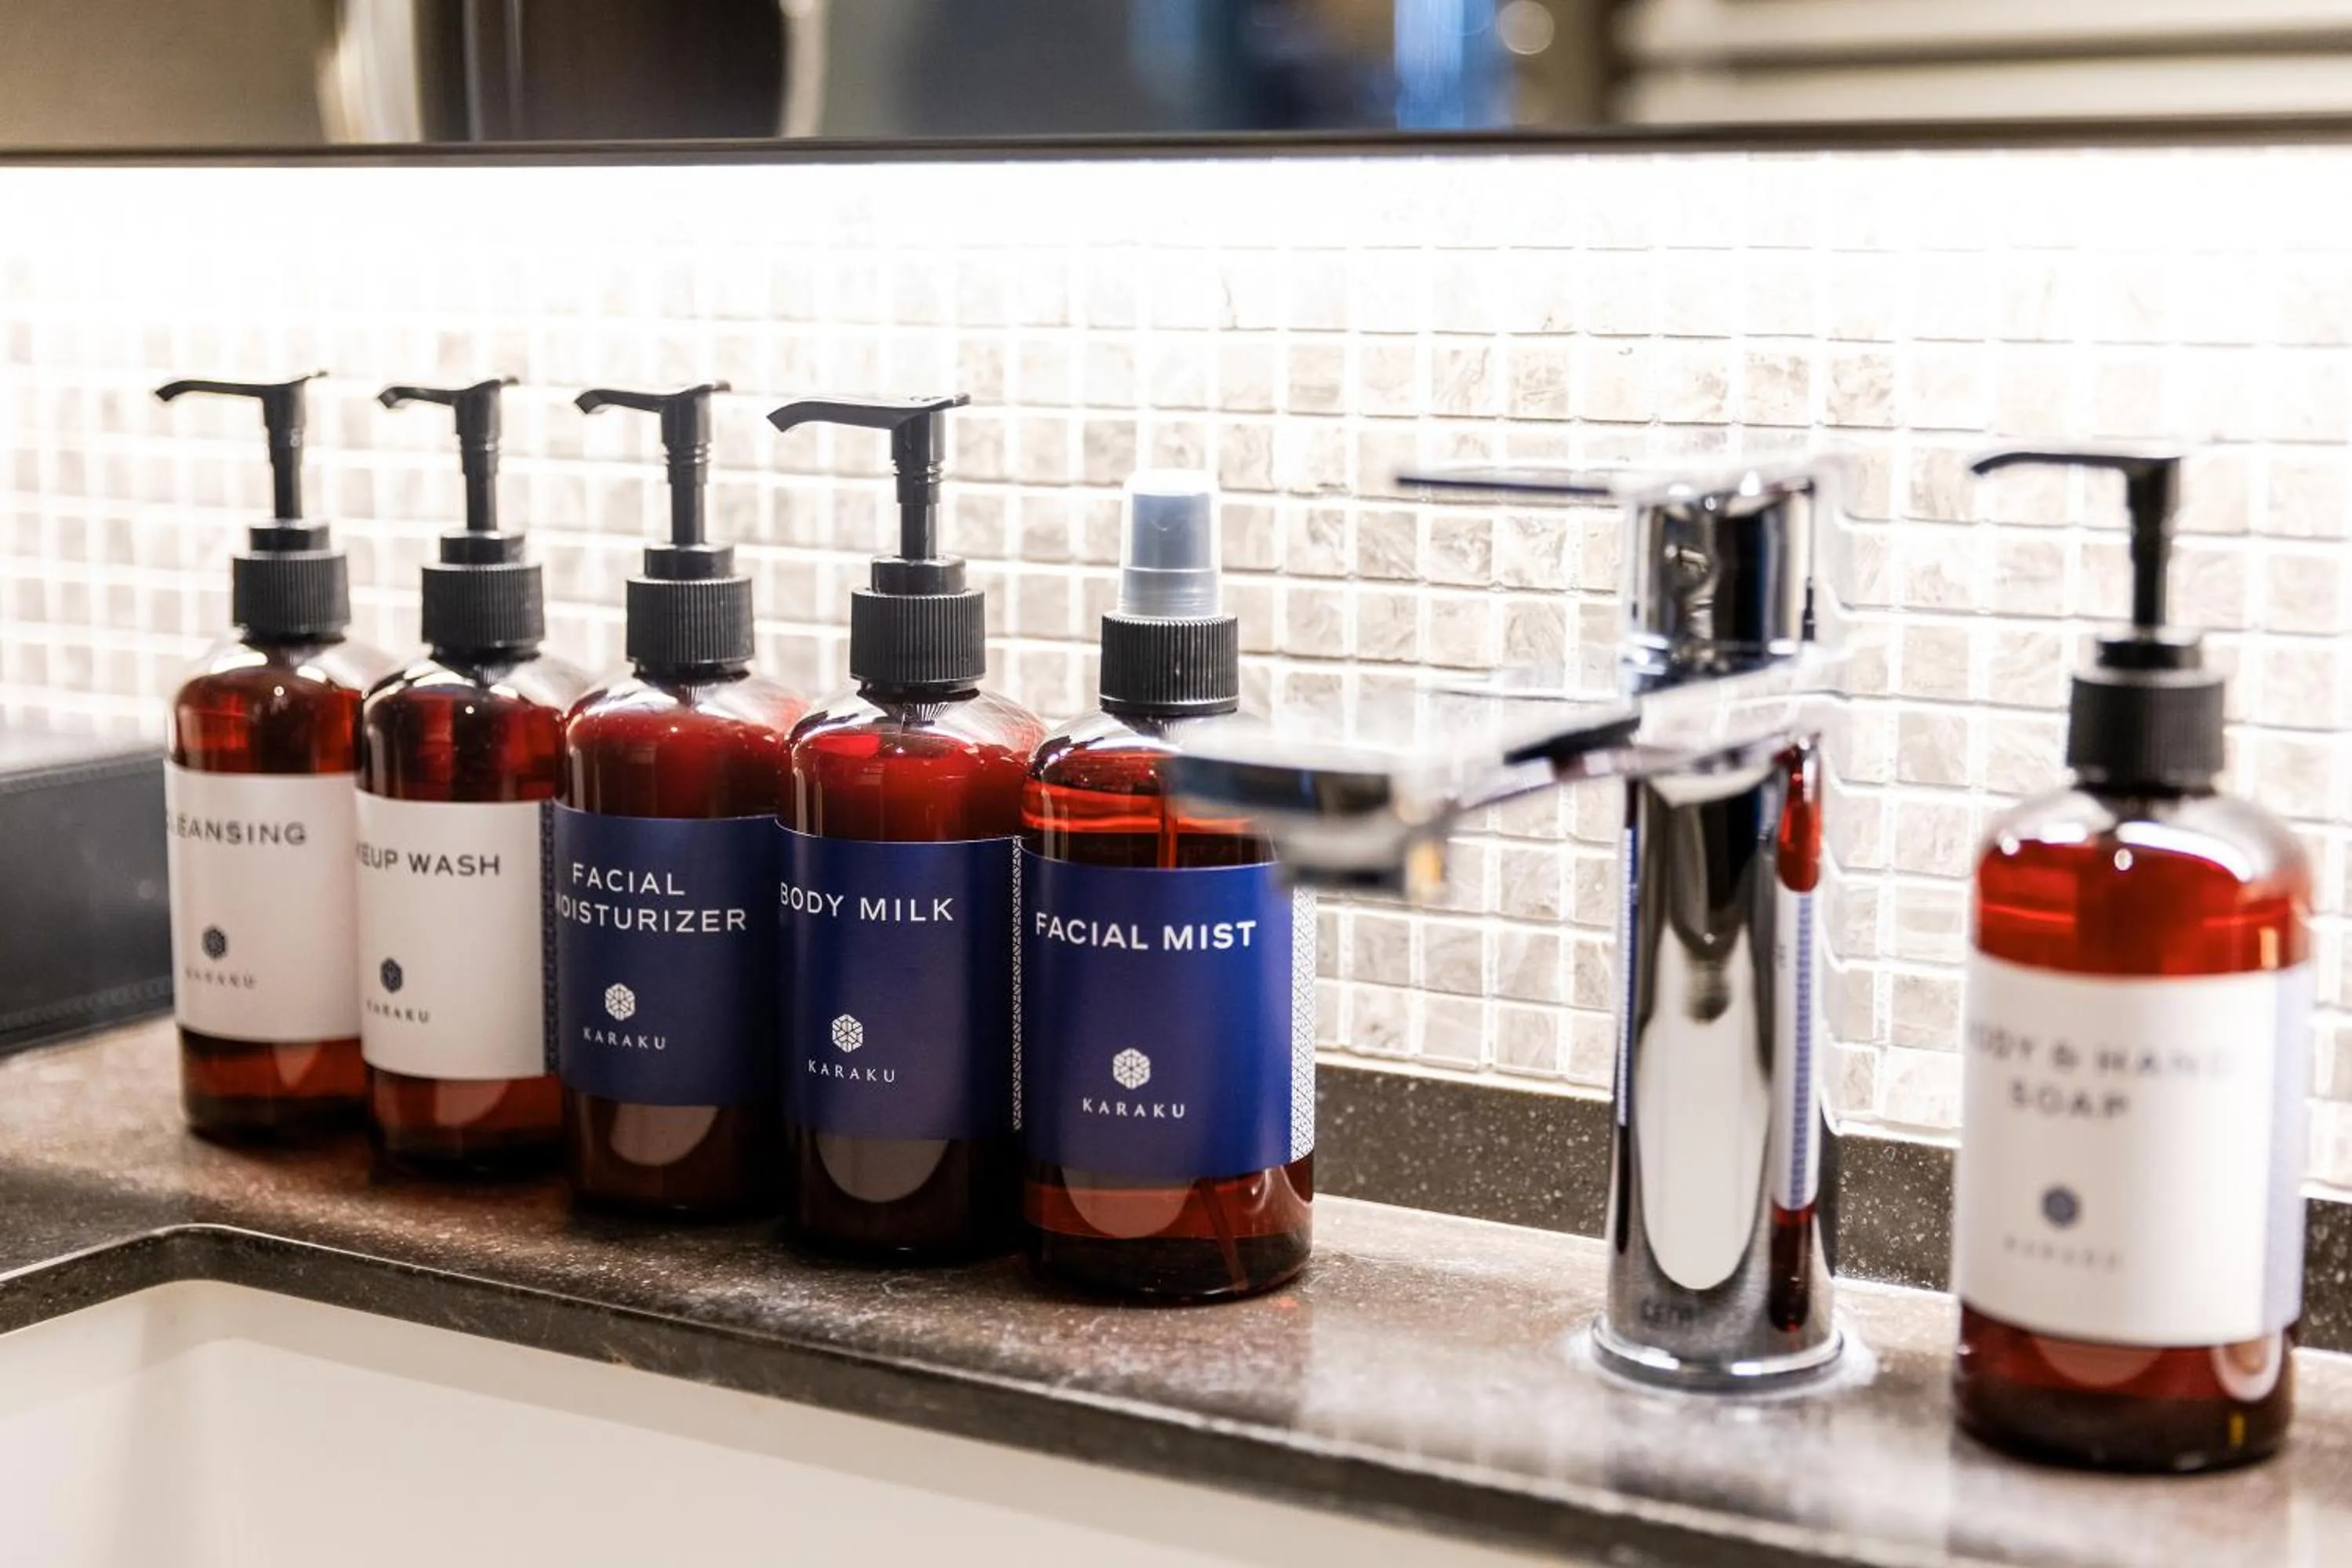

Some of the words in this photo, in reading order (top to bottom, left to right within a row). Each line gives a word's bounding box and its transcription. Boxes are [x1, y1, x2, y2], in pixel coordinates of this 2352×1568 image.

[408, 852, 500, 877] WASH
[572, 862, 685, 896] FACIAL
[780, 881, 844, 917] BODY
[860, 897, 954, 922] MILK
[1036, 912, 1149, 950] FACIAL
[1163, 920, 1258, 951] MIST
[583, 1026, 666, 1051] KARAKU
[1969, 1021, 2036, 1062] ODY
[808, 1059, 895, 1083] KARAKU
[1082, 1097, 1185, 1120] KARAKU
[2009, 1074, 2132, 1120] SOAP
